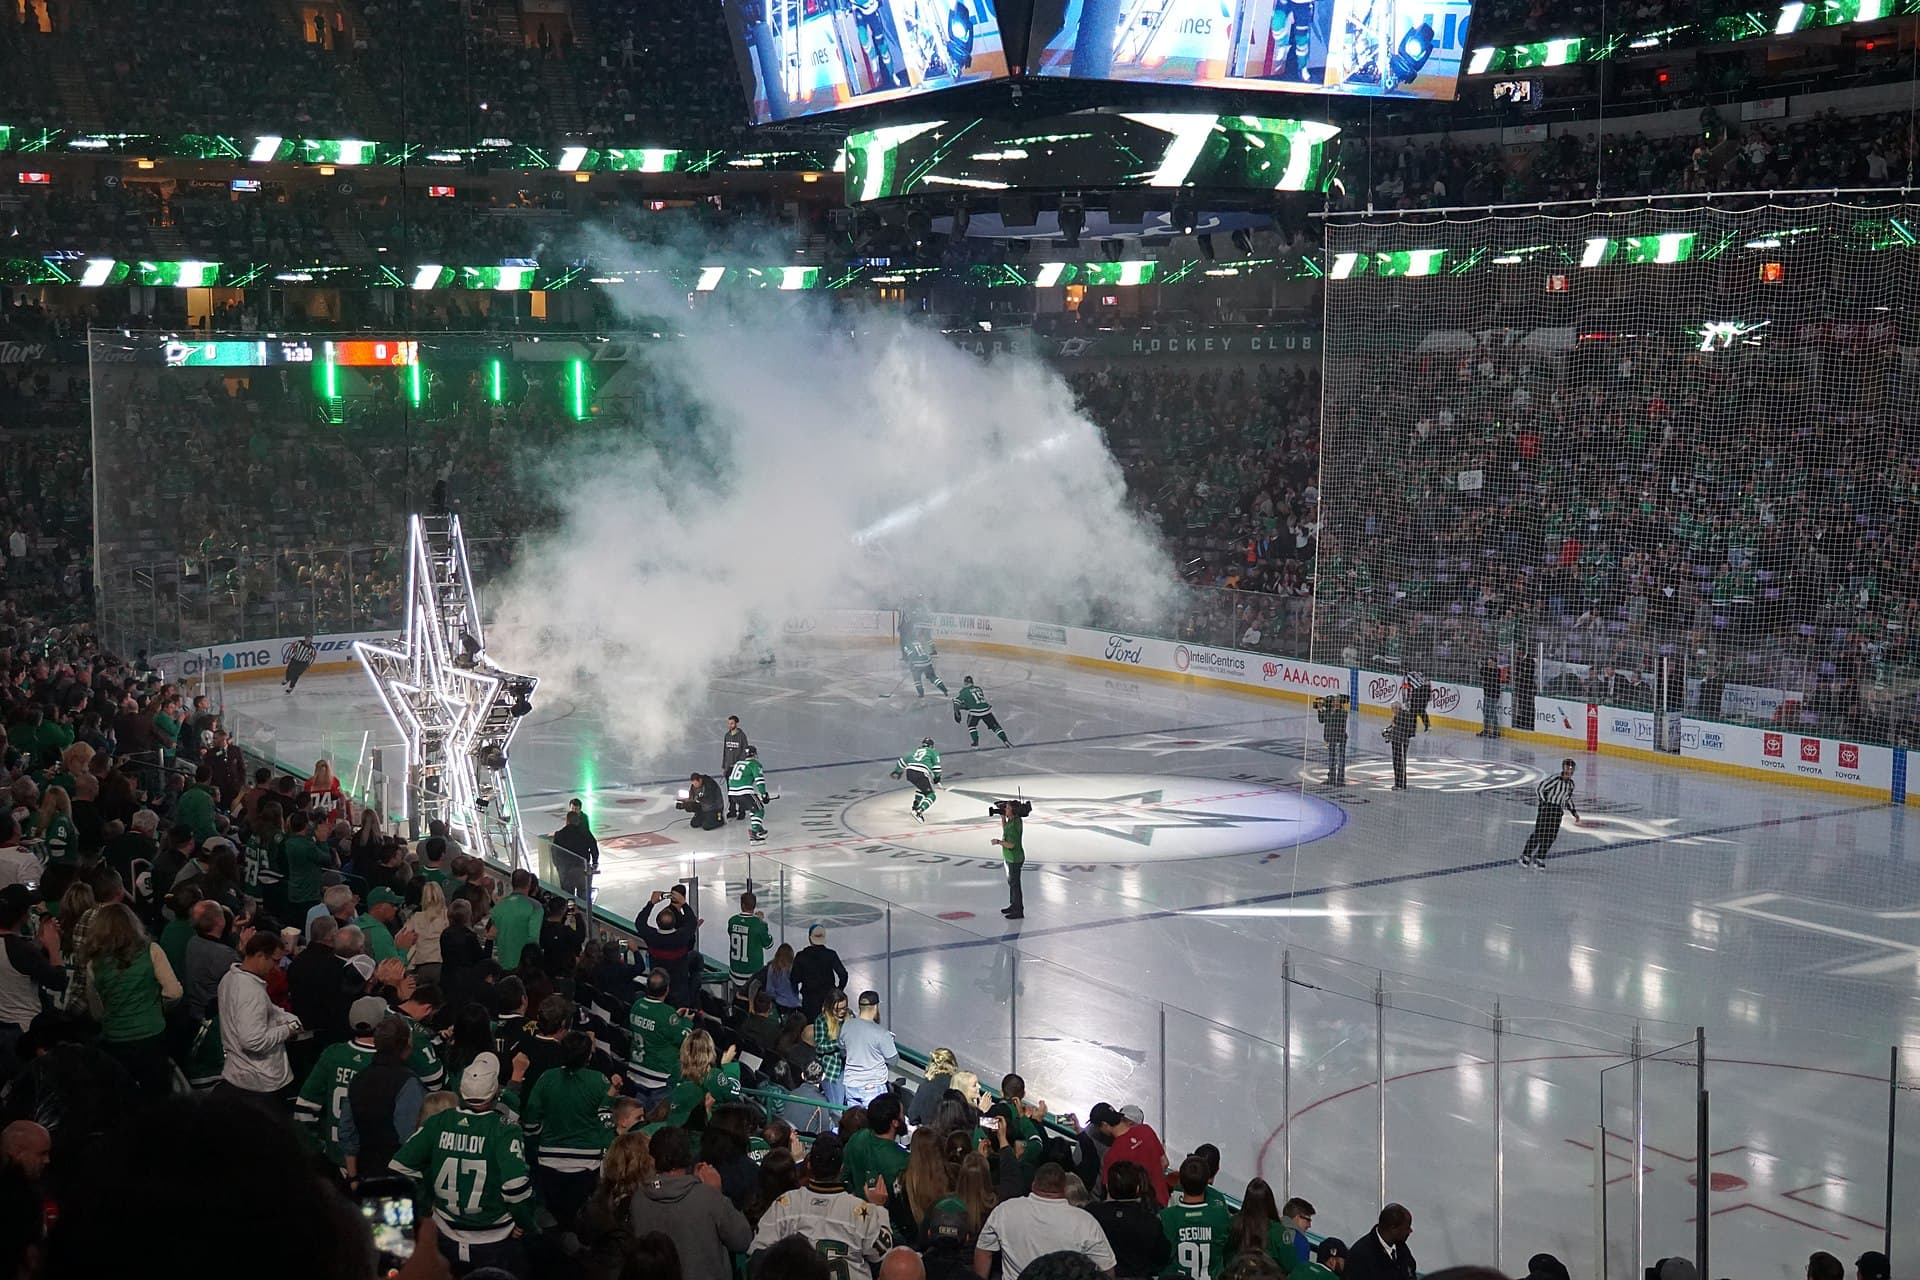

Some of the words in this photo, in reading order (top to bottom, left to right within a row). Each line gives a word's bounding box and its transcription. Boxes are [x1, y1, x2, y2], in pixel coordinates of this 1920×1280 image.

[206, 344, 214, 359] 0
[376, 344, 385, 359] 0
[959, 341, 1019, 354] TARS
[1132, 337, 1232, 352] HOCKEY
[1251, 336, 1312, 351] CLUB
[958, 619, 976, 630] WIN
[977, 620, 993, 631] BIG.
[1104, 635, 1144, 664] Ford
[1190, 650, 1245, 669] IntelliCentrics
[1283, 667, 1340, 689] AAA.com
[1378, 677, 1389, 689] Dr
[1369, 679, 1395, 700] Pepper
[1440, 686, 1451, 698] Dr
[1431, 688, 1458, 710] Pepper
[1611, 725, 1631, 735] LIGHT
[1614, 719, 1630, 727] BUD
[1702, 739, 1723, 749] LIGHT
[1705, 732, 1721, 741] BUD
[1761, 759, 1785, 769] TOYOTA
[1797, 765, 1823, 775] TOYOTA
[729, 764, 746, 780] 16
[1835, 770, 1861, 781] TOYOTA
[731, 933, 749, 963] 91
[434, 1156, 488, 1216] 47
[1178, 1226, 1212, 1241] SEGUIN
[1177, 1241, 1212, 1280] 91
